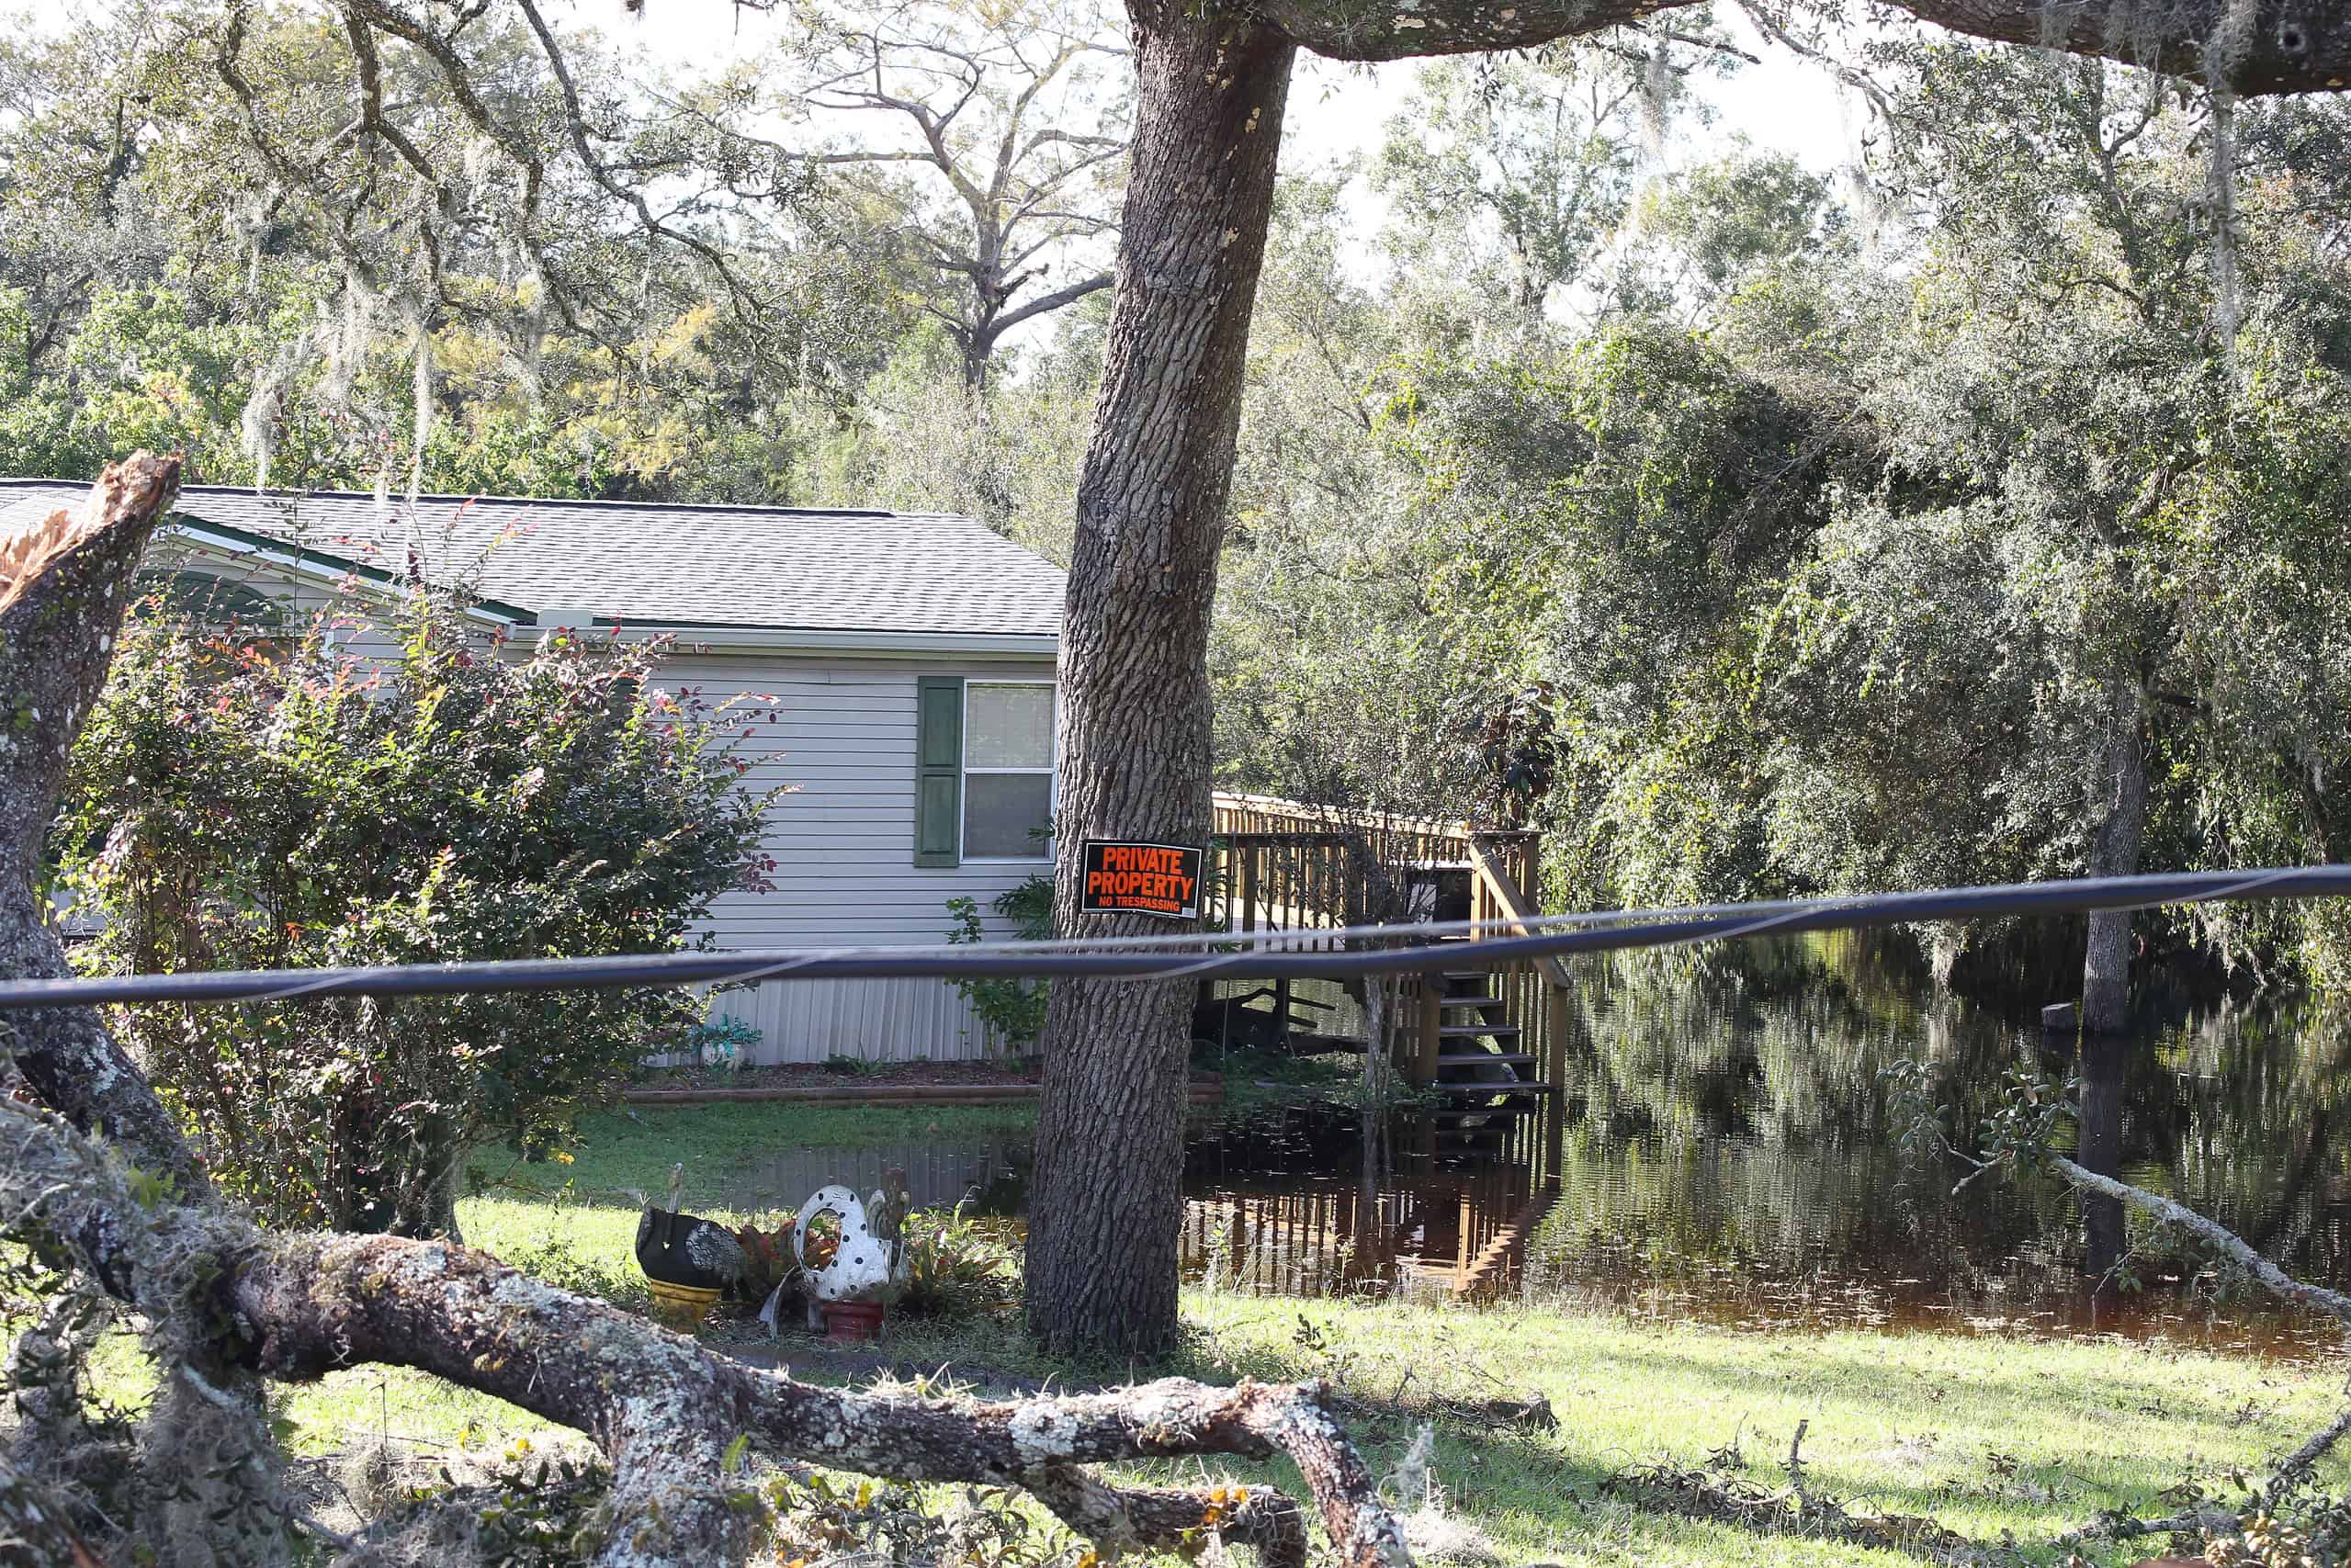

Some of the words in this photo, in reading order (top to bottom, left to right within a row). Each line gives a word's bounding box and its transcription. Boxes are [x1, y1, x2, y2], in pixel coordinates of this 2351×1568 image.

[1102, 847, 1183, 874] PRIVATE
[1088, 871, 1193, 900] PROPERTY
[1099, 897, 1113, 907] NO
[1116, 897, 1180, 911] TRESPASSING
